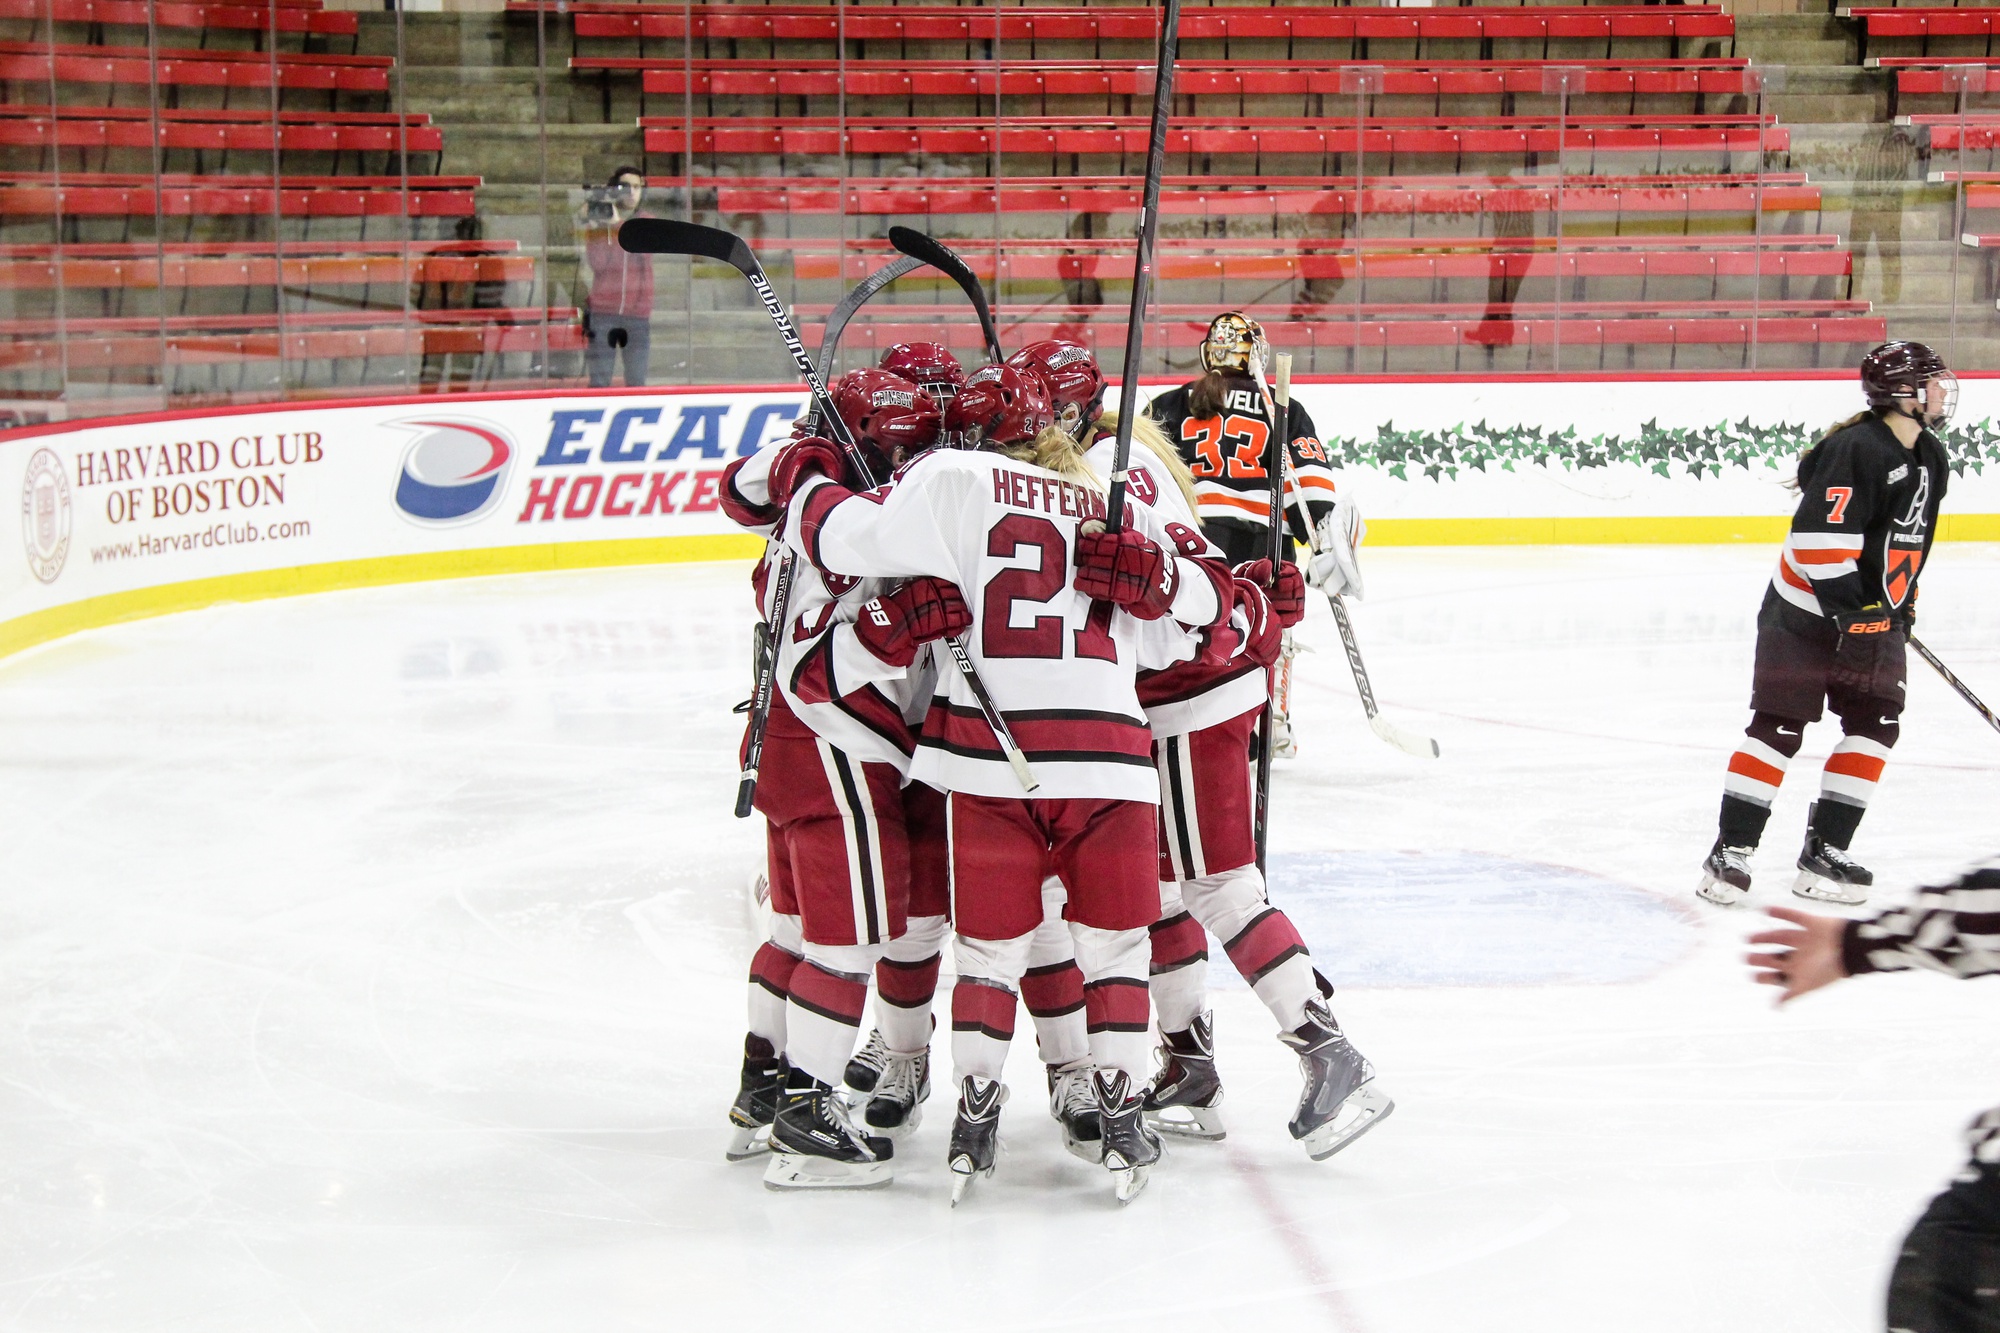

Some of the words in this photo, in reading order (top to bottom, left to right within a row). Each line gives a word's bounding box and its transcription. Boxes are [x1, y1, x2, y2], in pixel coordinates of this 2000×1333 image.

[750, 272, 815, 371] SUPREME
[807, 372, 827, 399] MX3
[872, 390, 913, 410] CRIMSON
[76, 439, 219, 488] HARVARD
[230, 431, 324, 470] CLUB
[535, 402, 803, 467] ECAC
[1181, 414, 1270, 478] 33
[1292, 436, 1326, 463] 33
[106, 488, 142, 524] OF
[152, 473, 287, 519] BOSTON
[516, 470, 722, 524] HOCKE
[991, 467, 1136, 530] HEFFERNN
[1825, 486, 1853, 524] 7
[90, 519, 311, 564] www.HarvardClub.com
[1848, 617, 1891, 634] BAU
[755, 669, 769, 709] BAUER
